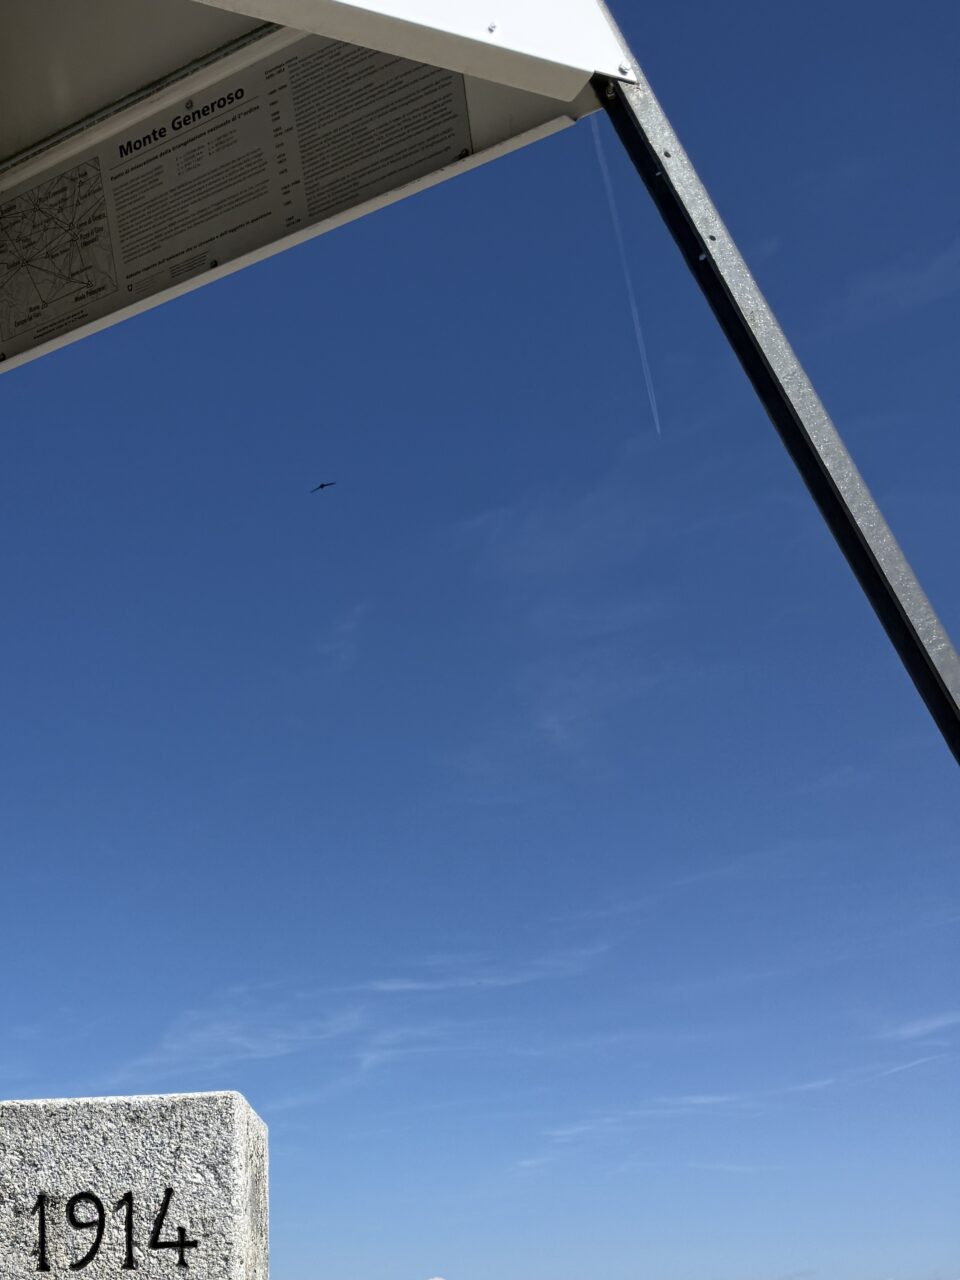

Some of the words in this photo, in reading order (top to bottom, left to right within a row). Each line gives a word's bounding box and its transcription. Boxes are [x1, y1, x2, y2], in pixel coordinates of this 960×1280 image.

[119, 126, 167, 158] Monte
[171, 88, 244, 131] Generoso
[31, 1187, 198, 1272] 1914
